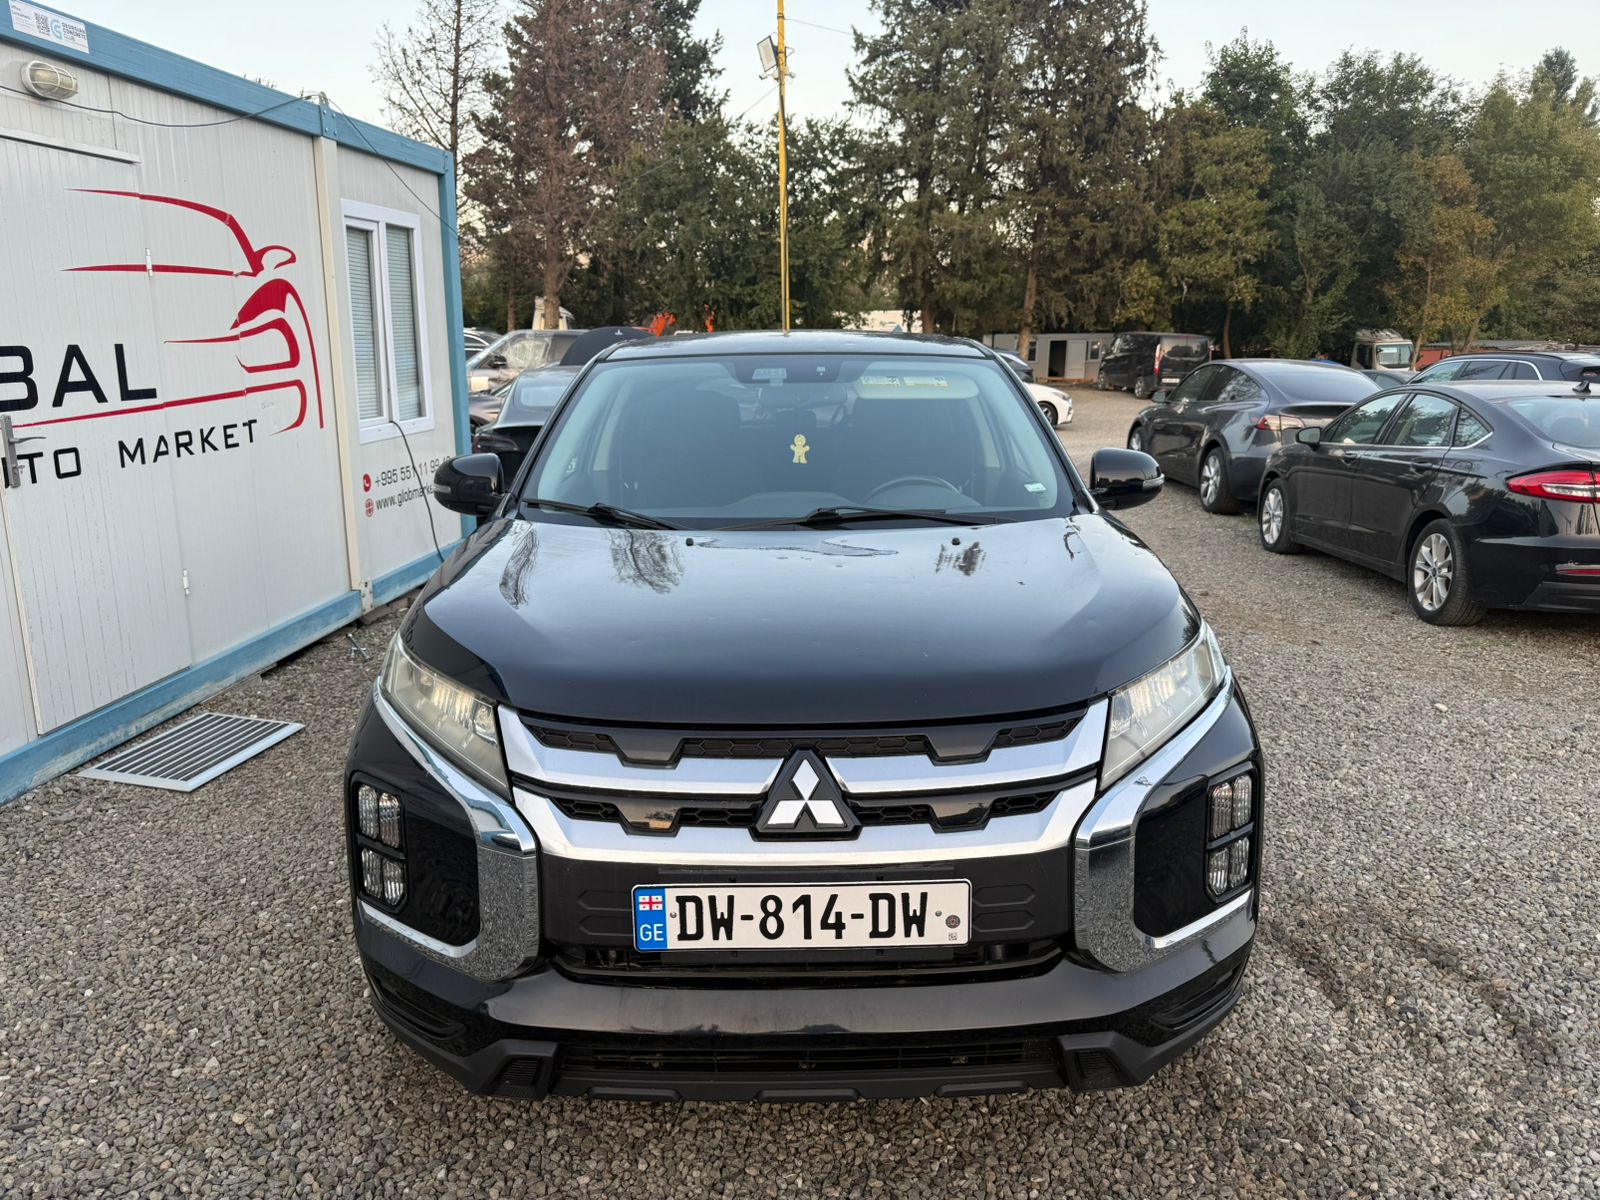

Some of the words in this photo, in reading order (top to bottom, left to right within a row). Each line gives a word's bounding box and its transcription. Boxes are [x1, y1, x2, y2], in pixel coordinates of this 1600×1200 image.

[62, 28, 87, 40] CONCRETE
[63, 34, 76, 42] CLUB
[118, 419, 258, 469] MARKET
[375, 469, 399, 487] +995
[400, 465, 416, 481] 551
[419, 461, 429, 475] 11
[375, 482, 434, 510] www.globmarke
[639, 923, 665, 942] GE
[675, 891, 929, 941] DW-814-DW
